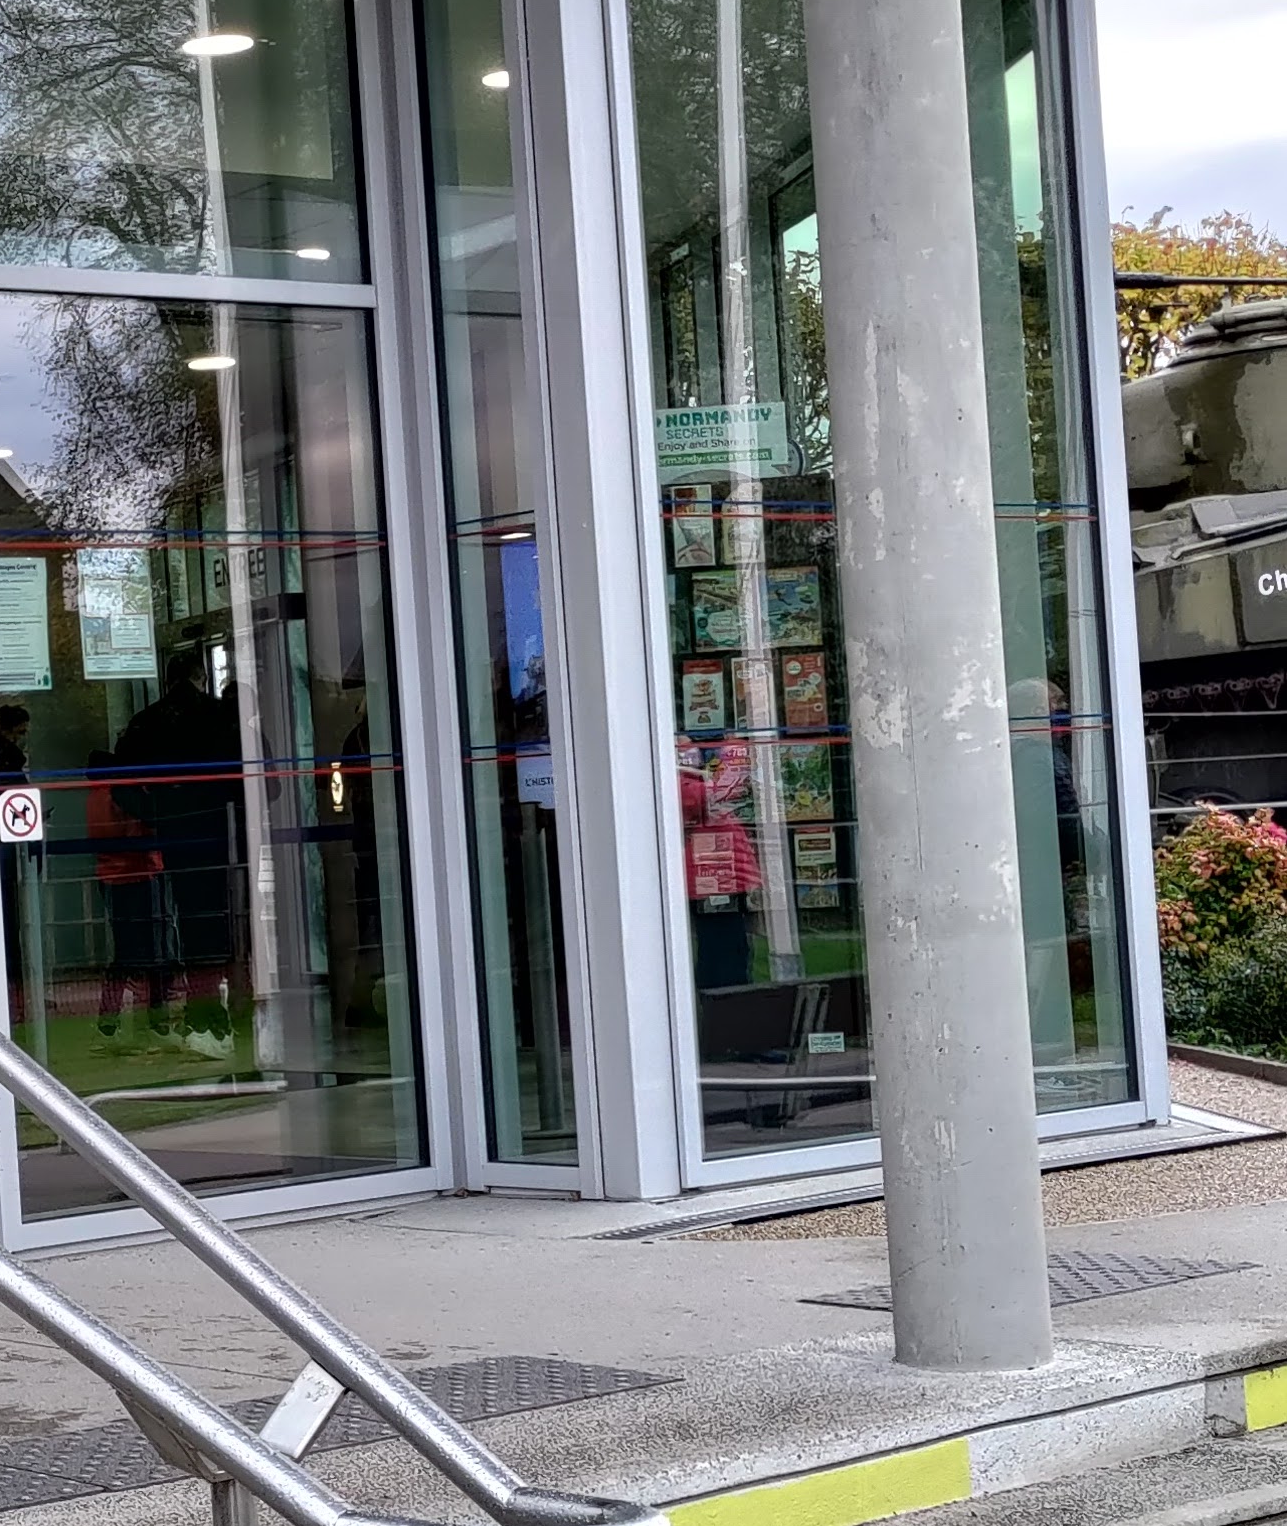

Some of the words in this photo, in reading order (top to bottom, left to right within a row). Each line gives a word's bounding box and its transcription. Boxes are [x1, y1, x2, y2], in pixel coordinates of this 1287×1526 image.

[666, 407, 772, 428] NORMANDY
[666, 426, 724, 440] SECRETS
[657, 442, 685, 453] Enjoy
[689, 439, 708, 449] and
